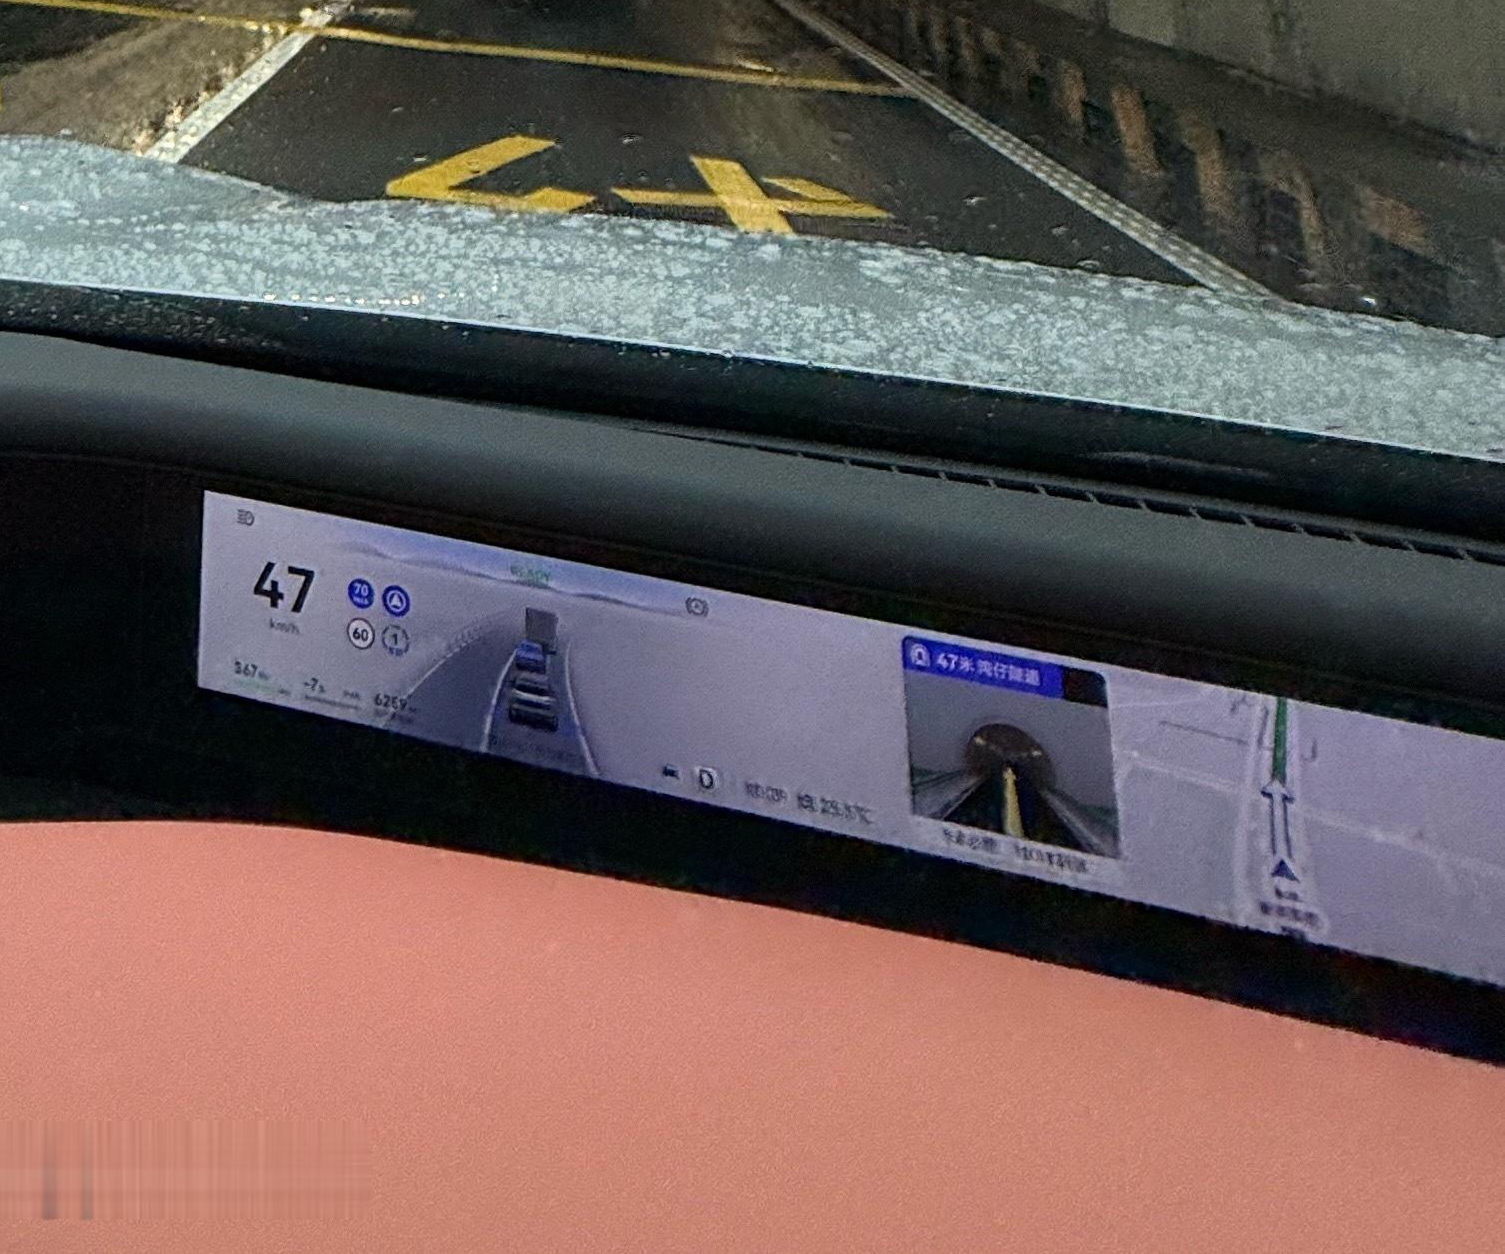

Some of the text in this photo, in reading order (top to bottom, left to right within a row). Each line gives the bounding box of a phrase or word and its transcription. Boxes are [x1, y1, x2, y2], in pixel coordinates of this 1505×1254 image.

[254, 561, 315, 614] 47
[354, 582, 370, 596] 70
[352, 627, 369, 642] 60
[698, 768, 715, 790] D
